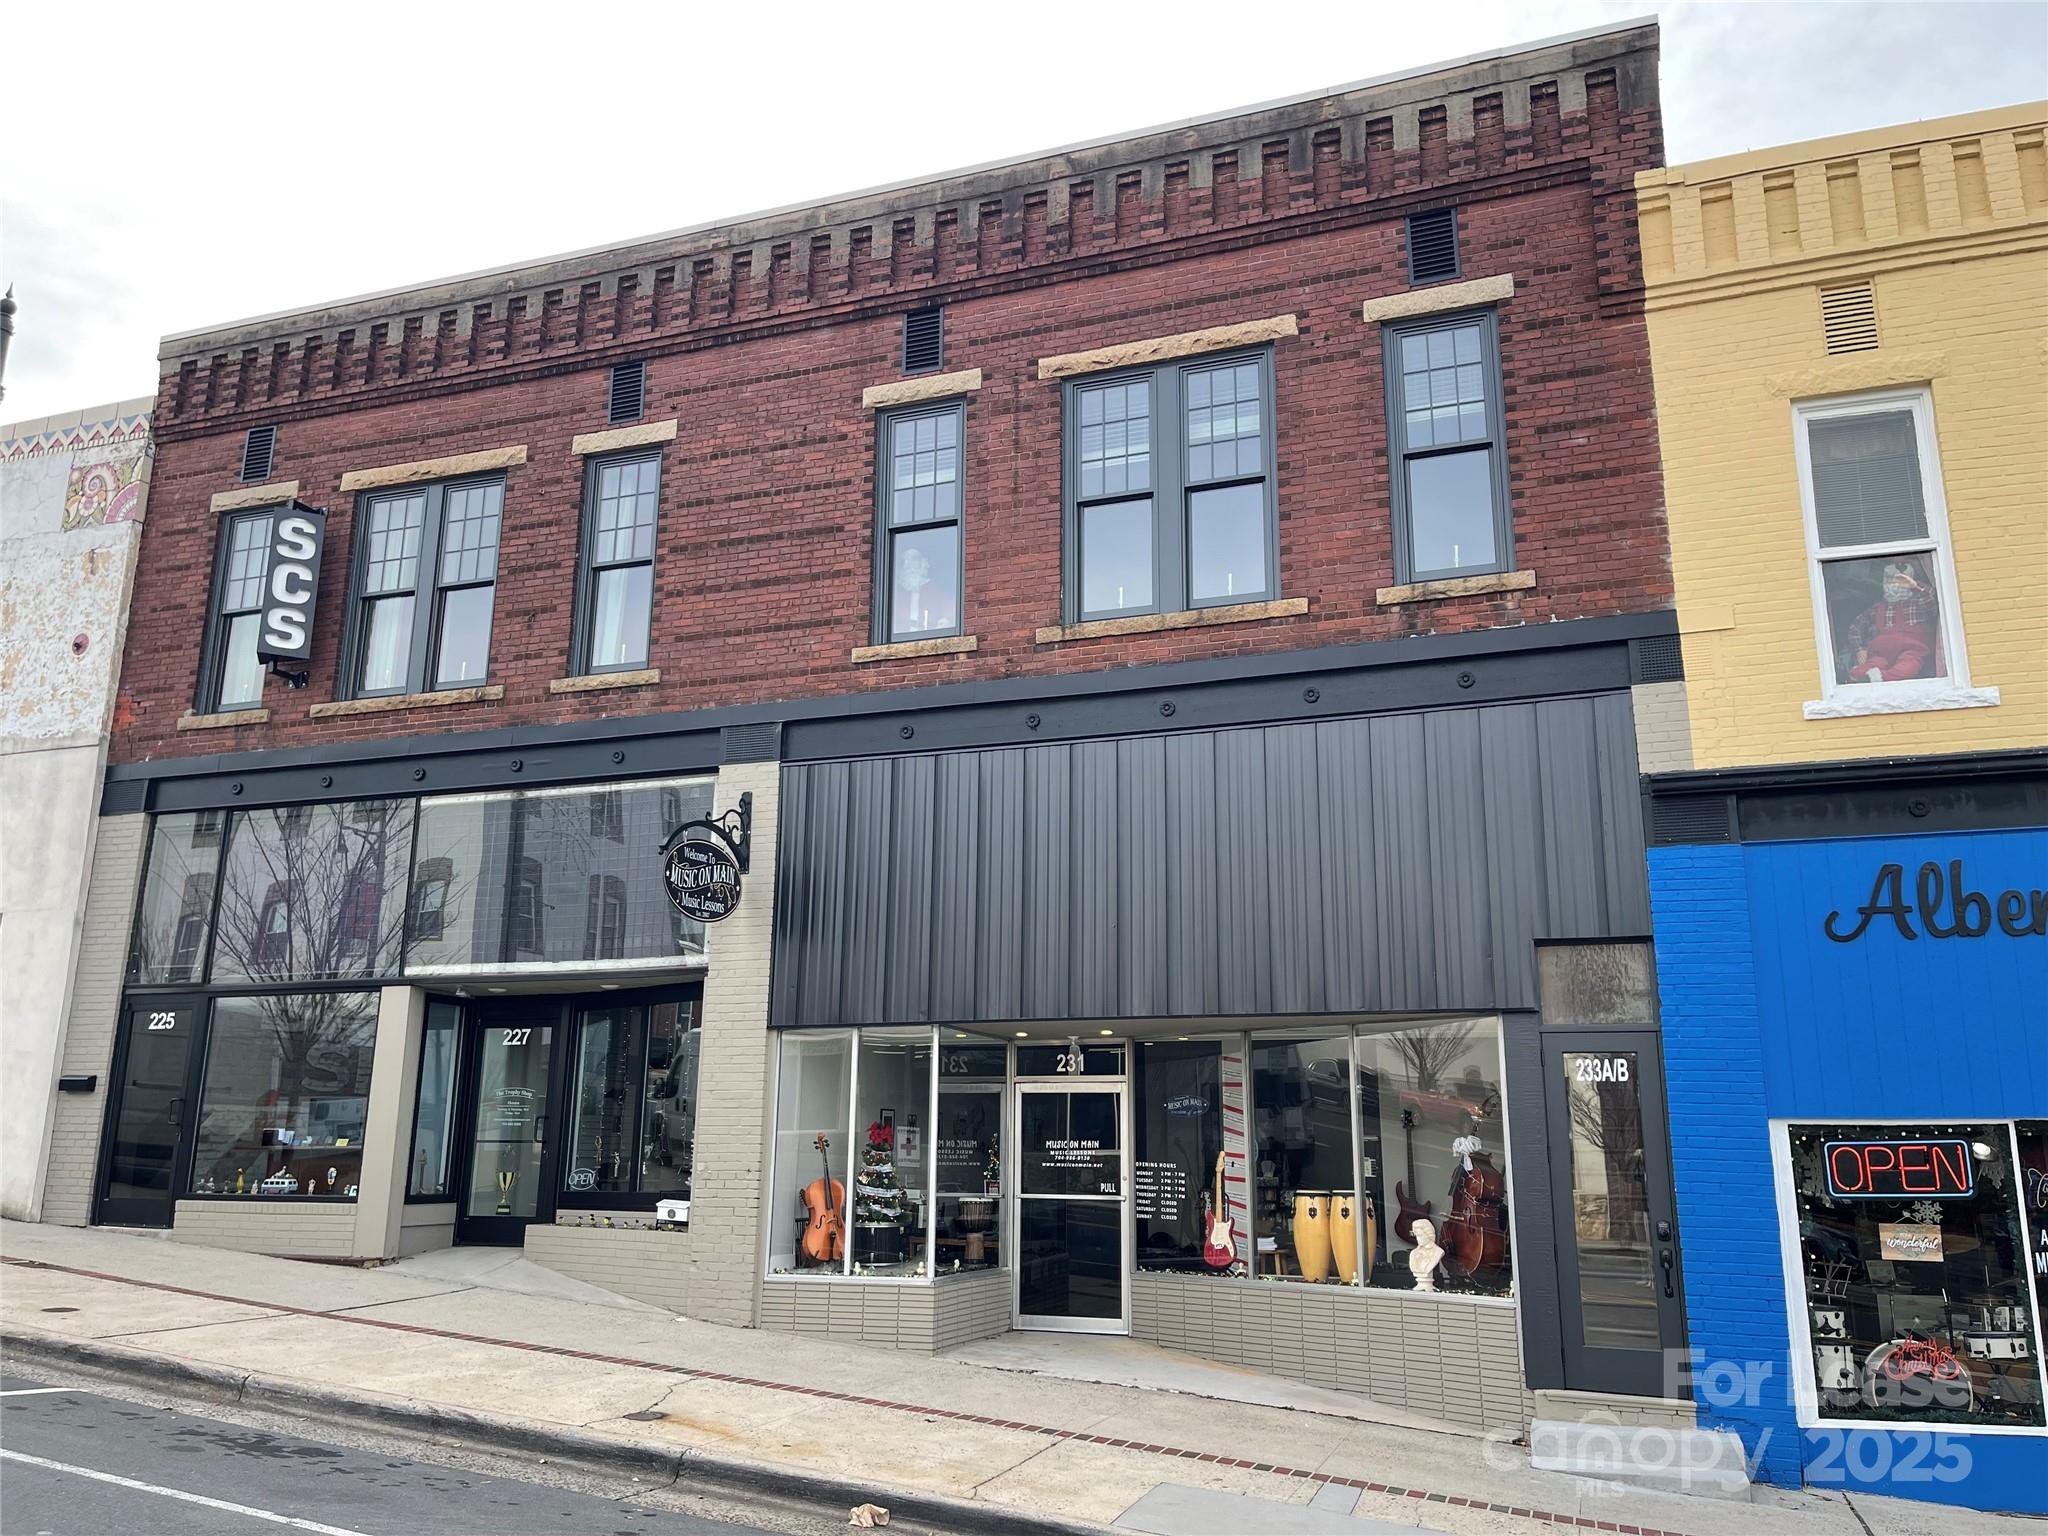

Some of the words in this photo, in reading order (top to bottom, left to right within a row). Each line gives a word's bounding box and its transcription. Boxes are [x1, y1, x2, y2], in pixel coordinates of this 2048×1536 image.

[264, 517, 318, 650] SCS
[684, 847, 708, 862] Welcome
[708, 853, 716, 864] To
[670, 864, 698, 888] MUSIC
[699, 866, 712, 886] ON
[713, 865, 736, 885] MAIN
[681, 892, 700, 909] Music
[701, 896, 725, 913] Lessons
[148, 1012, 176, 1030] 225
[502, 1028, 532, 1046] 227
[1056, 1054, 1085, 1072] 231
[1576, 1058, 1630, 1082] 233A/B
[1046, 1140, 1068, 1149] MUSIC
[1069, 1140, 1079, 1149] ON
[1081, 1140, 1100, 1149] MAIN
[1831, 1145, 1967, 1192] OPEN
[568, 1173, 595, 1185] OPEN
[1100, 1183, 1116, 1193] PULL
[1887, 1236, 1939, 1252] wonderful
